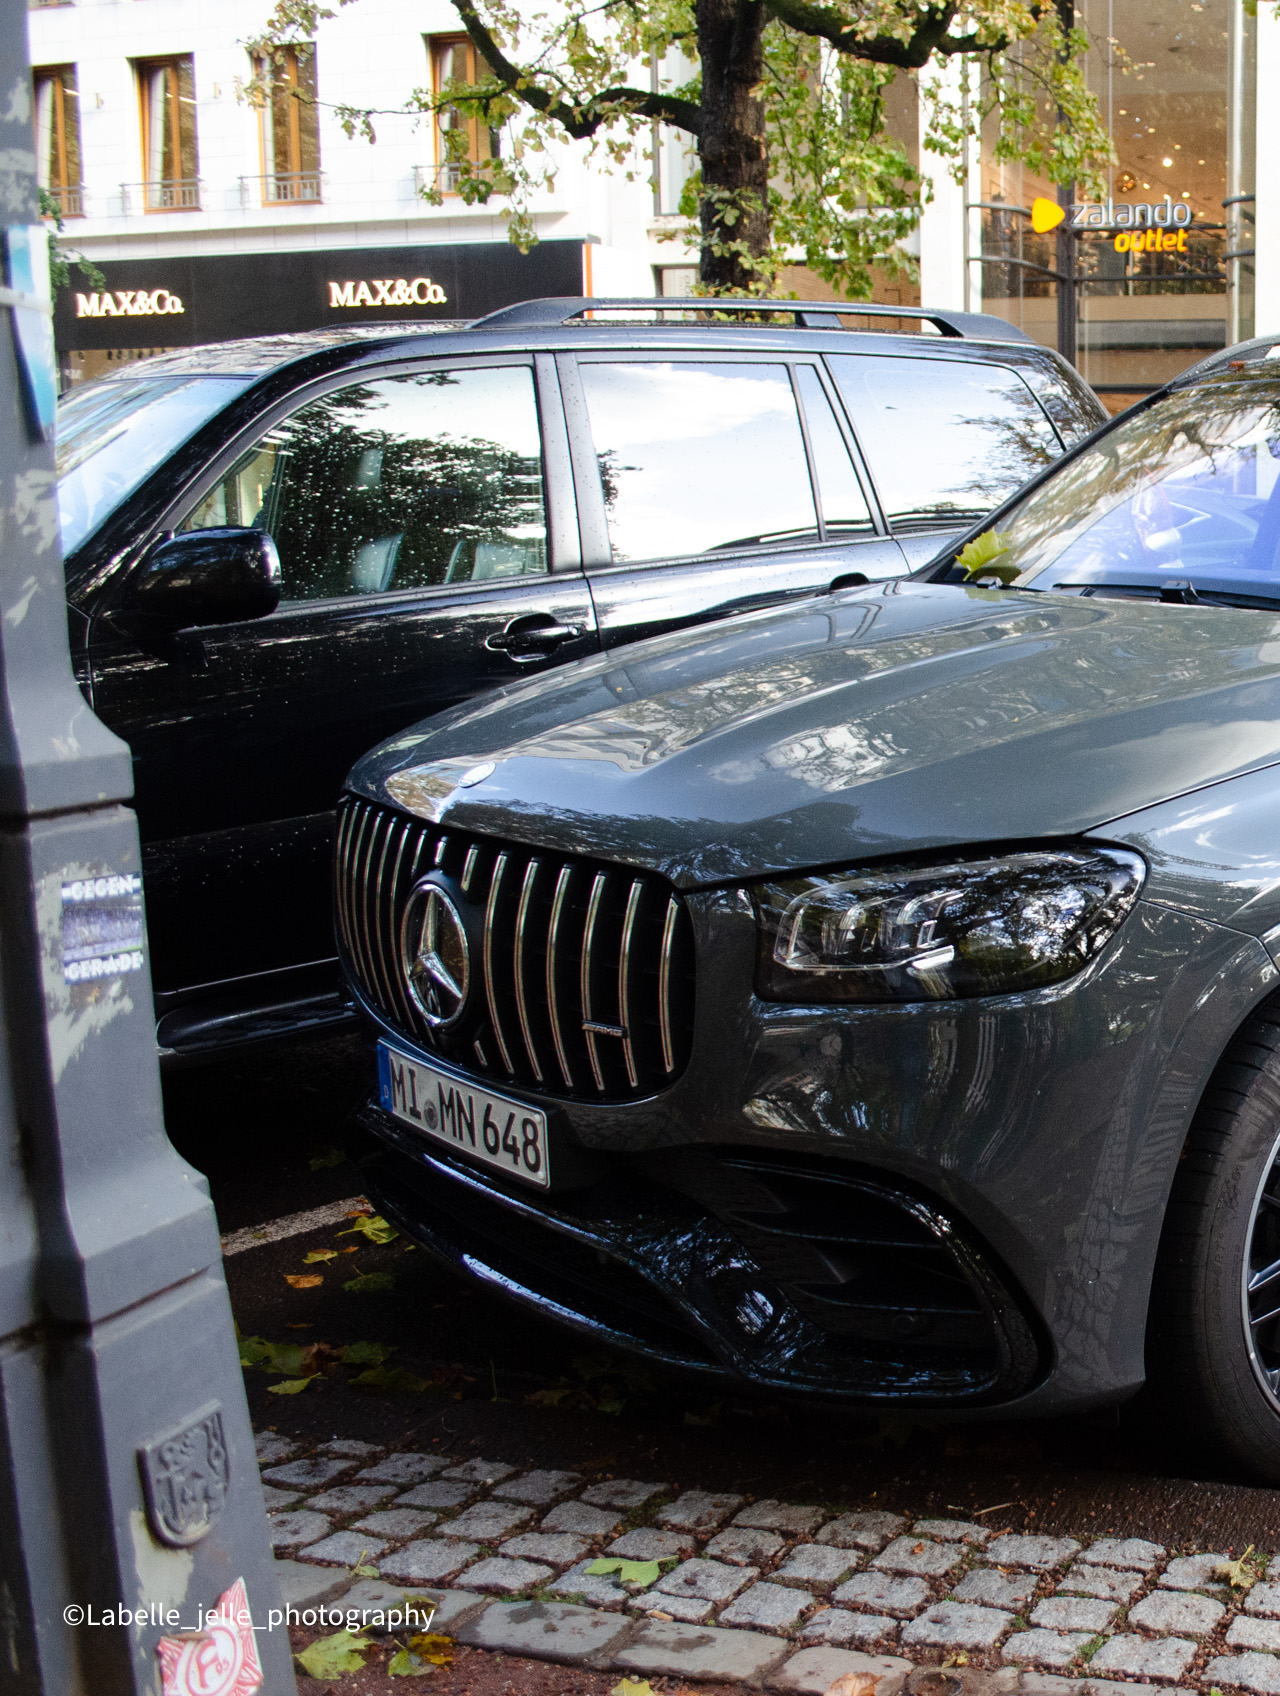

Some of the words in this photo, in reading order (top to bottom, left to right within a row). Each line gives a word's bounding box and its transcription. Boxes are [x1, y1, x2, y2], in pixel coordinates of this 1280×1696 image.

[1070, 194, 1192, 228] zalando
[1114, 228, 1189, 252] outlet
[76, 289, 185, 318] MAX&Co.
[328, 278, 447, 308] MAX&Co.
[71, 874, 134, 900] GEGEN
[68, 951, 142, 980] GERADE
[390, 1057, 423, 1121] MI
[438, 1080, 477, 1148] MN
[483, 1102, 542, 1173] 648
